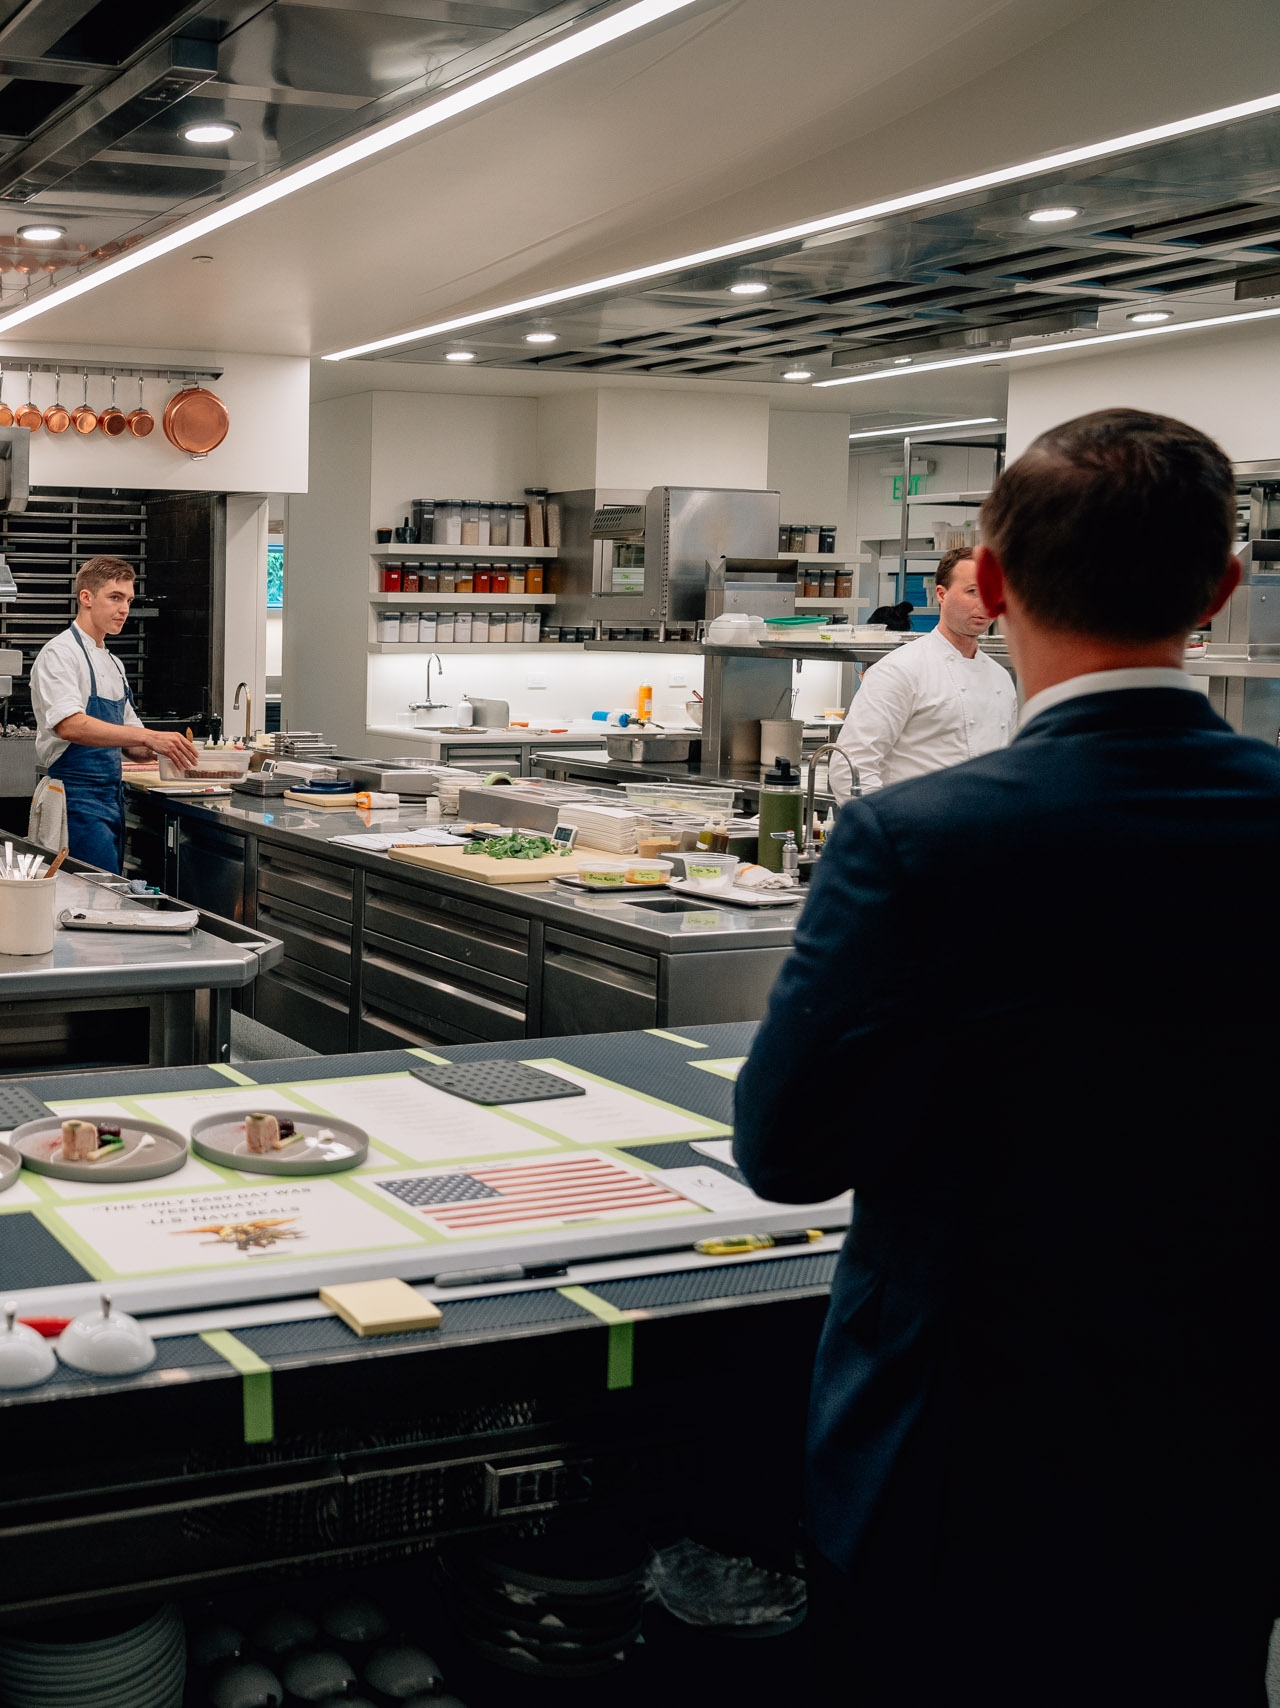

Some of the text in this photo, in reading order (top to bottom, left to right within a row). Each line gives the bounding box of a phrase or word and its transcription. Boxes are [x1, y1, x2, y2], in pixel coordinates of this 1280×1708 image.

[141, 1198, 185, 1208] ONLY
[191, 1194, 232, 1204] EASY
[237, 1191, 269, 1200] DAY
[275, 1186, 312, 1196] WAS
[193, 1211, 240, 1222] NAVY
[245, 1206, 301, 1217] SEALS
